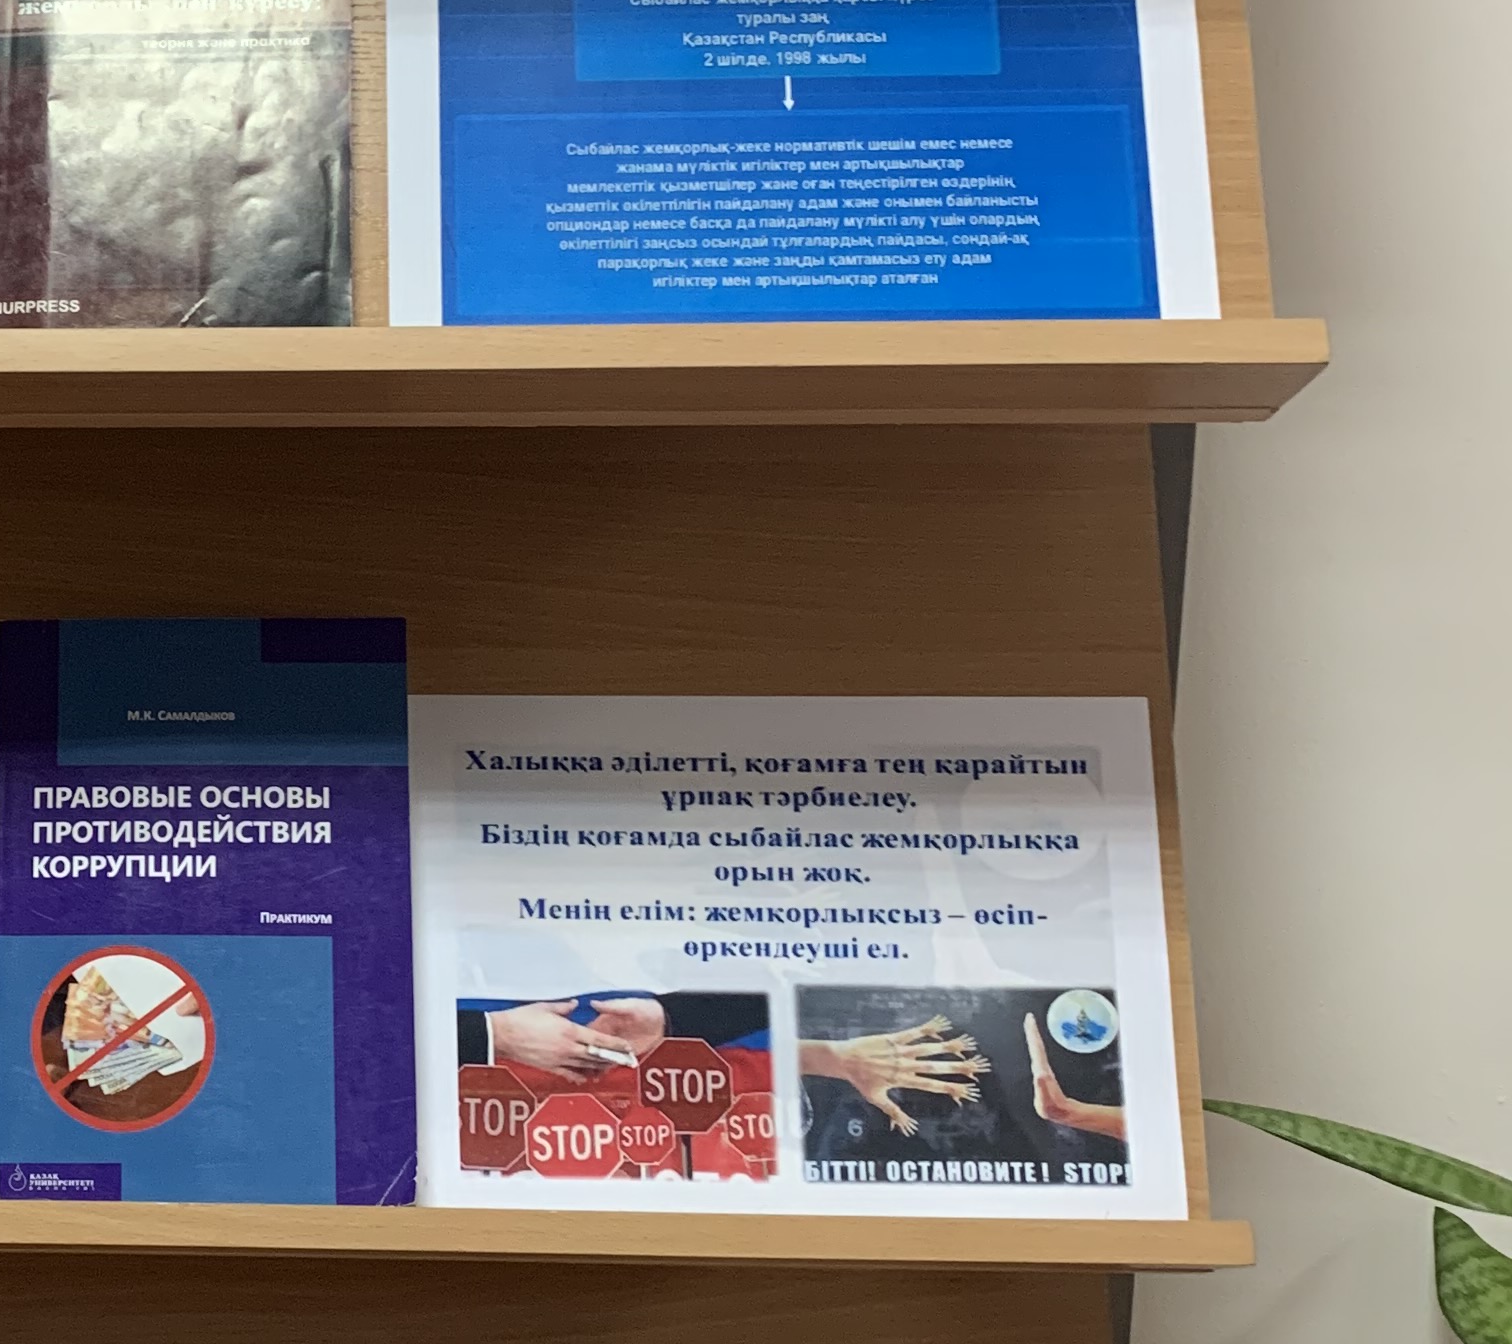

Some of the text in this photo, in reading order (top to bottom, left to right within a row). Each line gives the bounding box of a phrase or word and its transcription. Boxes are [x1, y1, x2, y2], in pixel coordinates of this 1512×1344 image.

[737, 13, 796, 27] туралы
[683, 32, 764, 47] Қазақстан
[776, 51, 812, 65] 1998
[128, 710, 155, 721] М.К.
[465, 750, 1088, 783] Халыққа қоғамға тең қарайтын
[33, 786, 331, 809] ПРАВОВЫЕ ОСНОВЫ
[33, 815, 332, 848] ПРОТИВОДЕЙСТВИЯ
[481, 824, 1079, 854] Біздің қоғамда сыбайлас жемқорлыққа
[32, 855, 217, 882] КОРРУПЦИИ
[714, 864, 795, 887] орын
[518, 898, 941, 930] Менің елім: жемқорлықсыз
[868, 937, 908, 960] ел.
[645, 1068, 726, 1104] STOP
[532, 1123, 614, 1161] STOP
[621, 1125, 670, 1147] STOP
[886, 1161, 1037, 1183] ОСТАНОВИТЕ
[1063, 1162, 1132, 1184] STOP!
